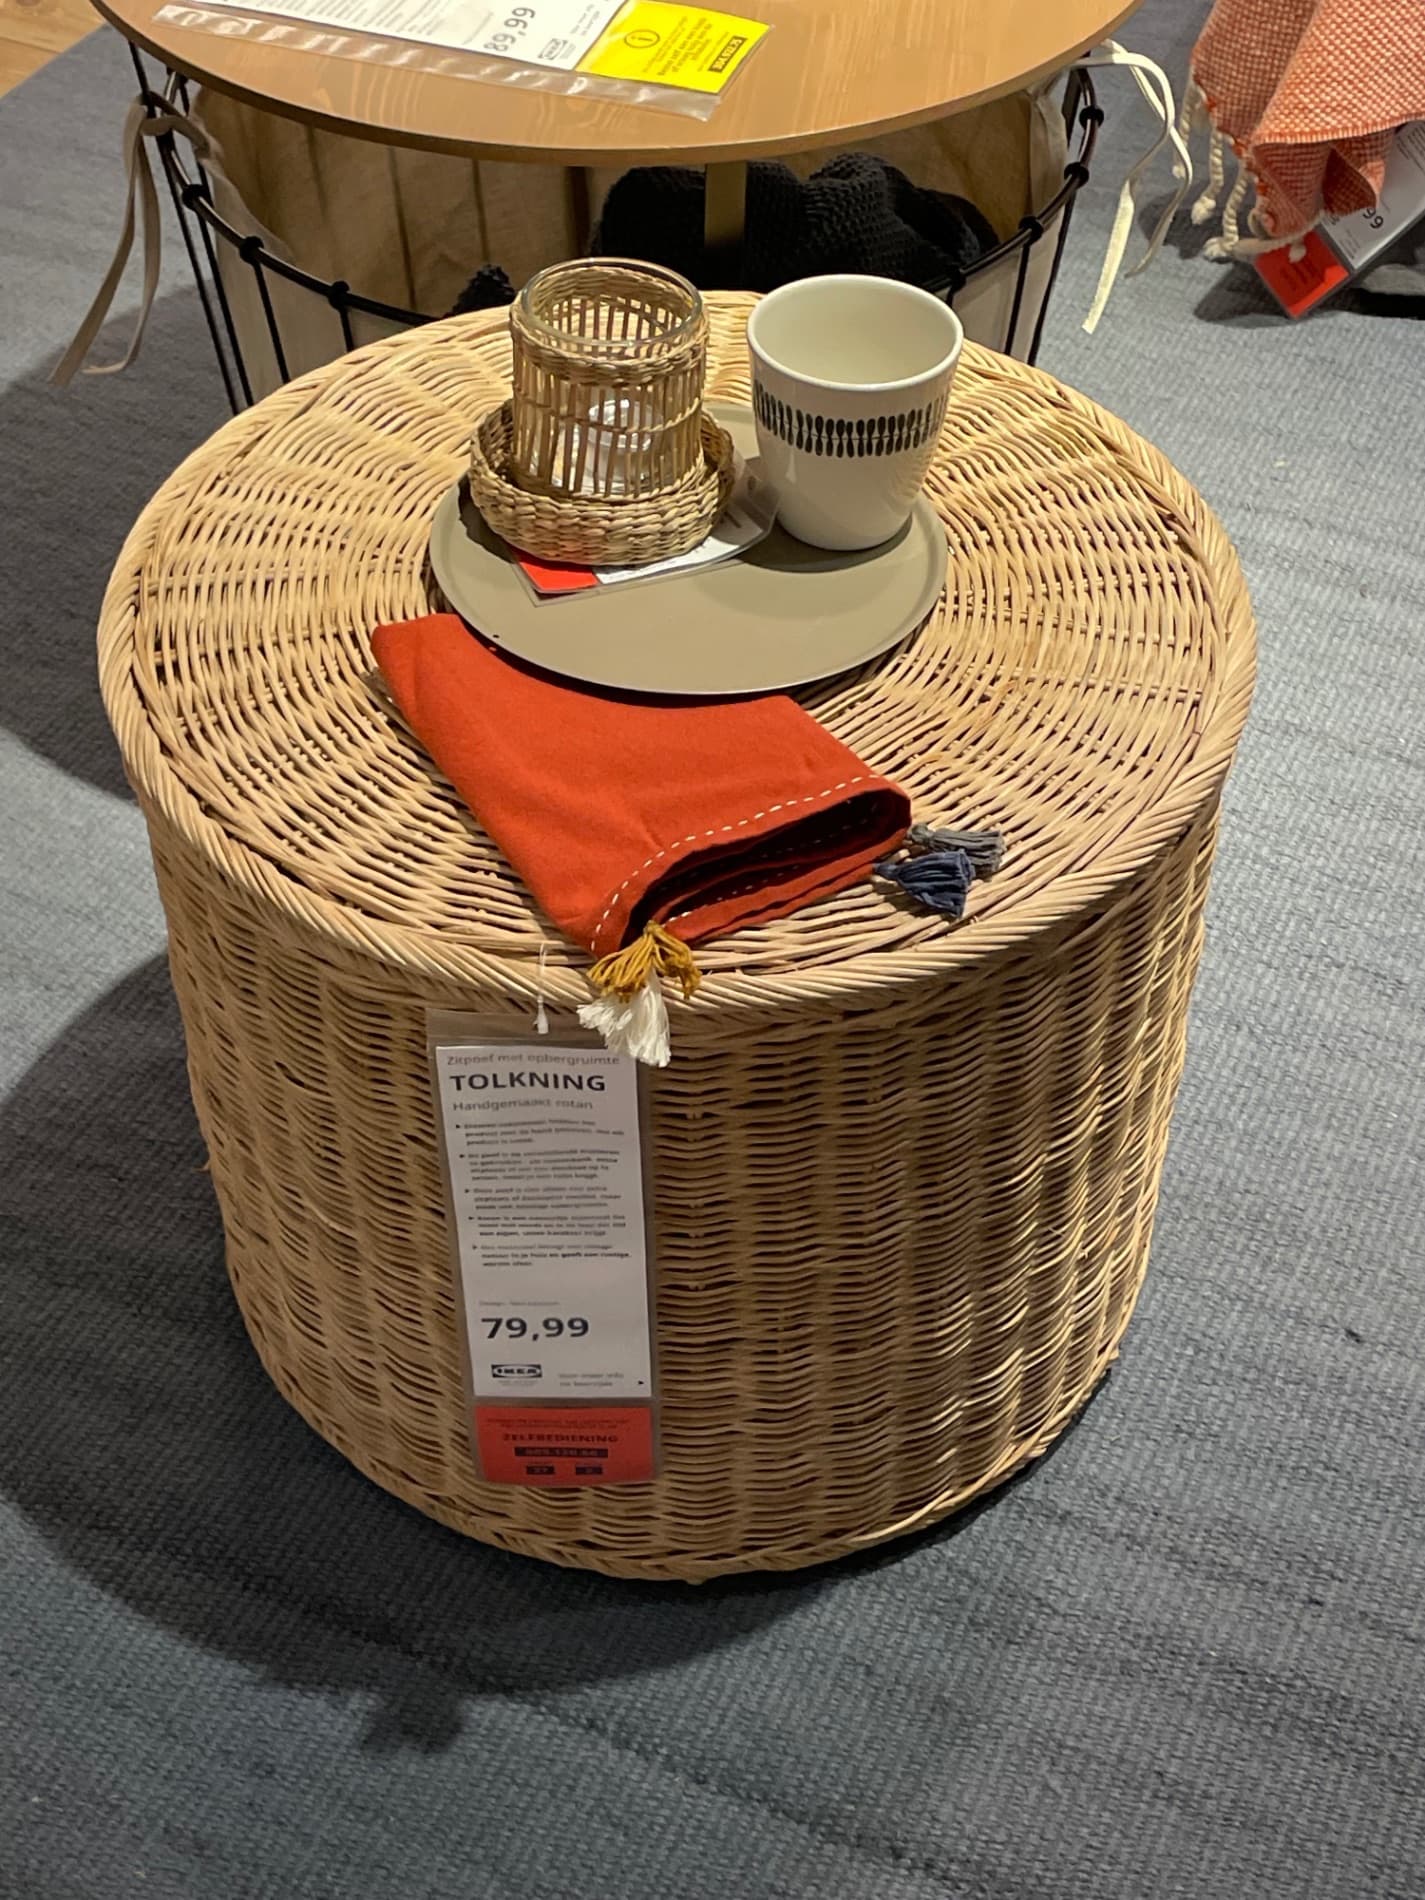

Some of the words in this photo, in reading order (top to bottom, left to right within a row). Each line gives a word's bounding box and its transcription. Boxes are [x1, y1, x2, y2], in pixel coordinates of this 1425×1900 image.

[483, 7, 535, 51] 89,99
[447, 1054, 494, 1066] Zitpoef
[498, 1053, 523, 1062] met
[527, 1054, 620, 1066] opbergruimte
[449, 1072, 605, 1091] TOLKNING
[453, 1099, 551, 1111] Handgemaakt
[556, 1099, 593, 1109] rotan
[481, 1317, 590, 1341] 79,99
